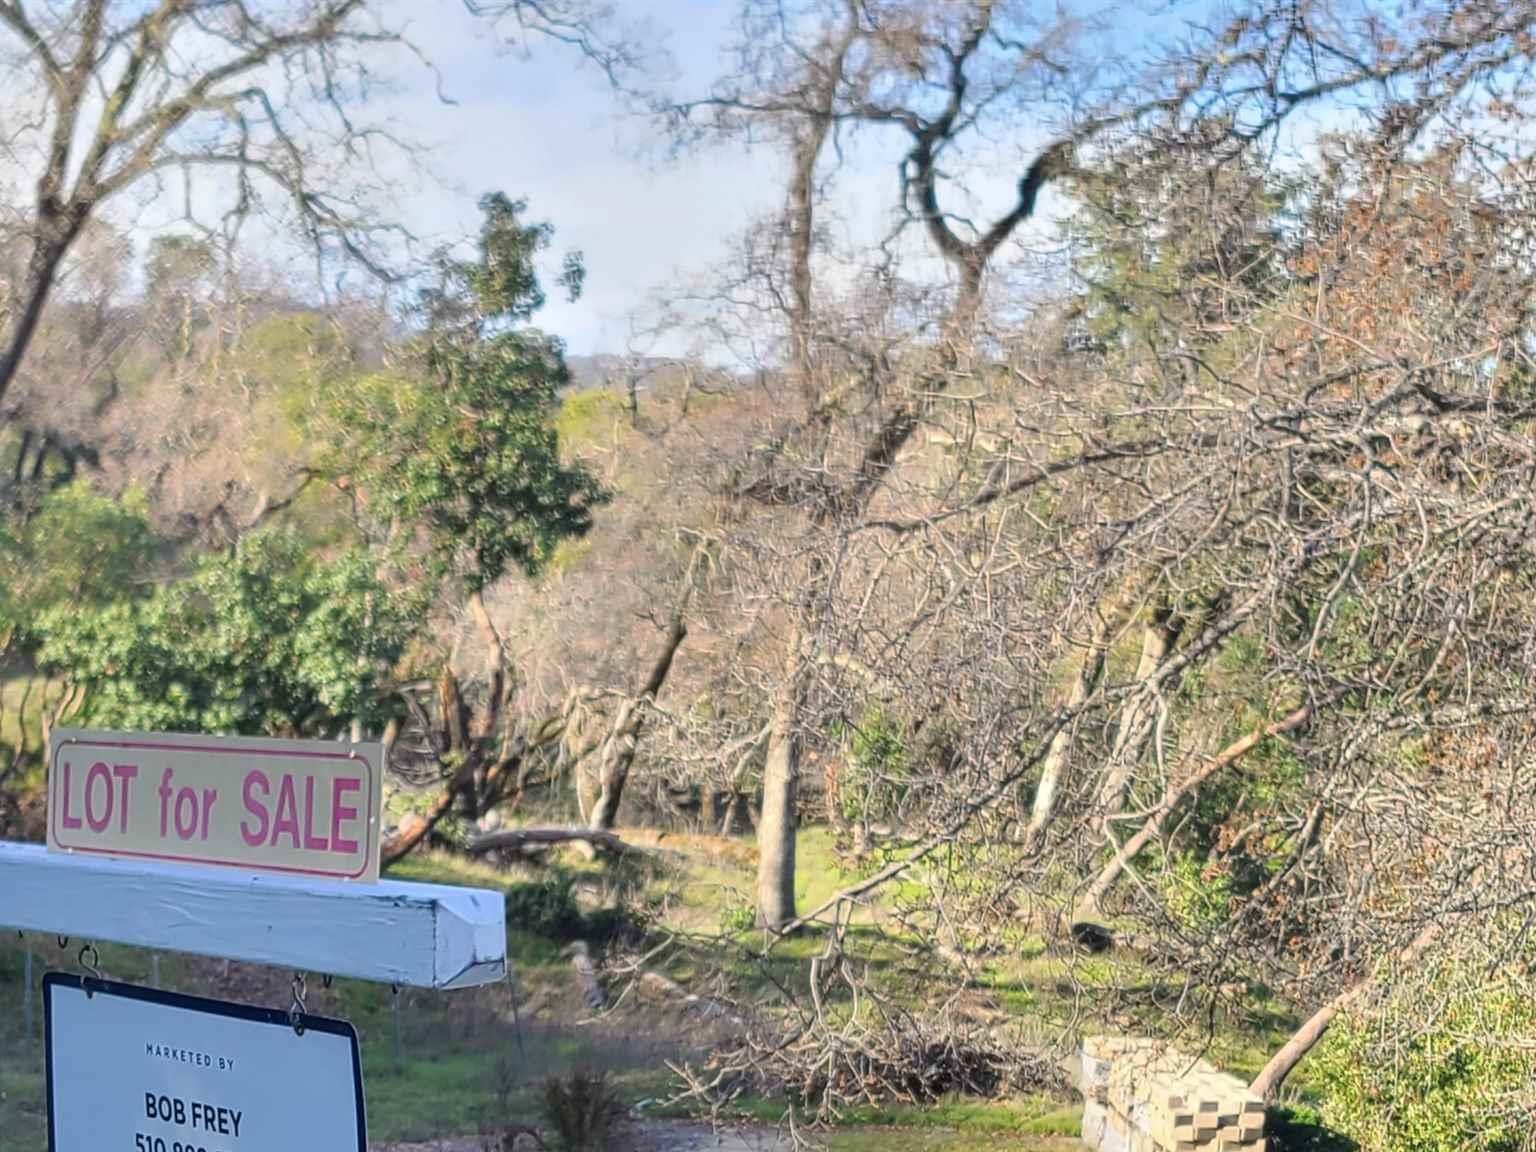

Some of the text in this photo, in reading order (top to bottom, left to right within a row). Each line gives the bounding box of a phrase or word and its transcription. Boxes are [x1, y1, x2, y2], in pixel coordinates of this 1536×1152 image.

[62, 761, 361, 854] LOT for SALE
[146, 1043, 234, 1071] MARKETED BY
[145, 1092, 242, 1137] BOB FREY
